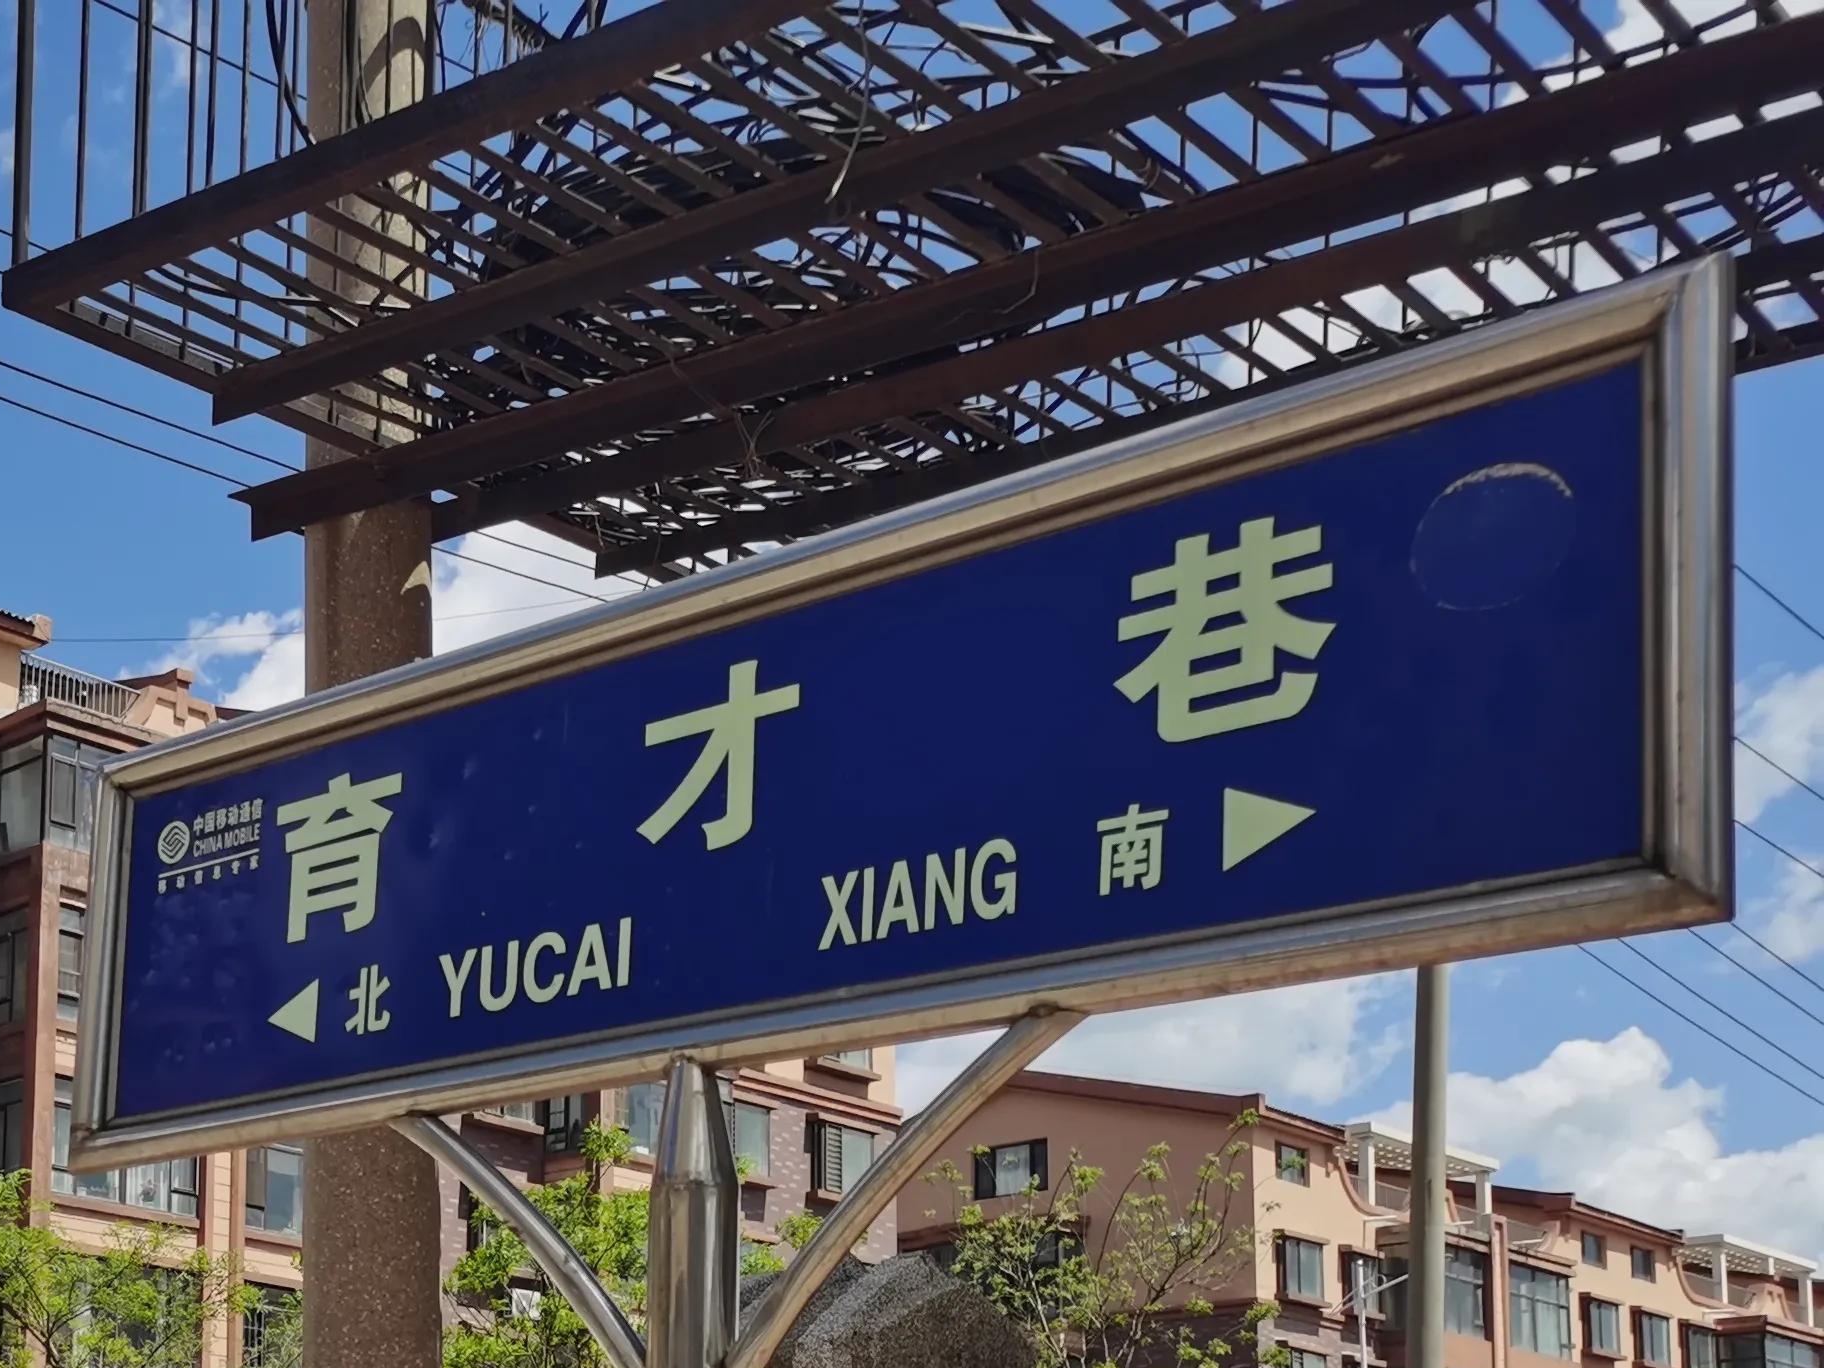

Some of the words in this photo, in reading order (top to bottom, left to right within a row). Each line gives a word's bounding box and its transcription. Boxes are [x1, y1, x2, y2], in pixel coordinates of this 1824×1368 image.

[277, 516, 1337, 943] 育才巷
[193, 798, 263, 836] 中国移动通信
[193, 834, 223, 857] CHINA
[224, 823, 260, 849] MOBILE
[1097, 803, 1170, 896] 南
[438, 916, 632, 1018] YUCAI
[818, 838, 1018, 951] XIANG
[344, 964, 390, 1035] 北
